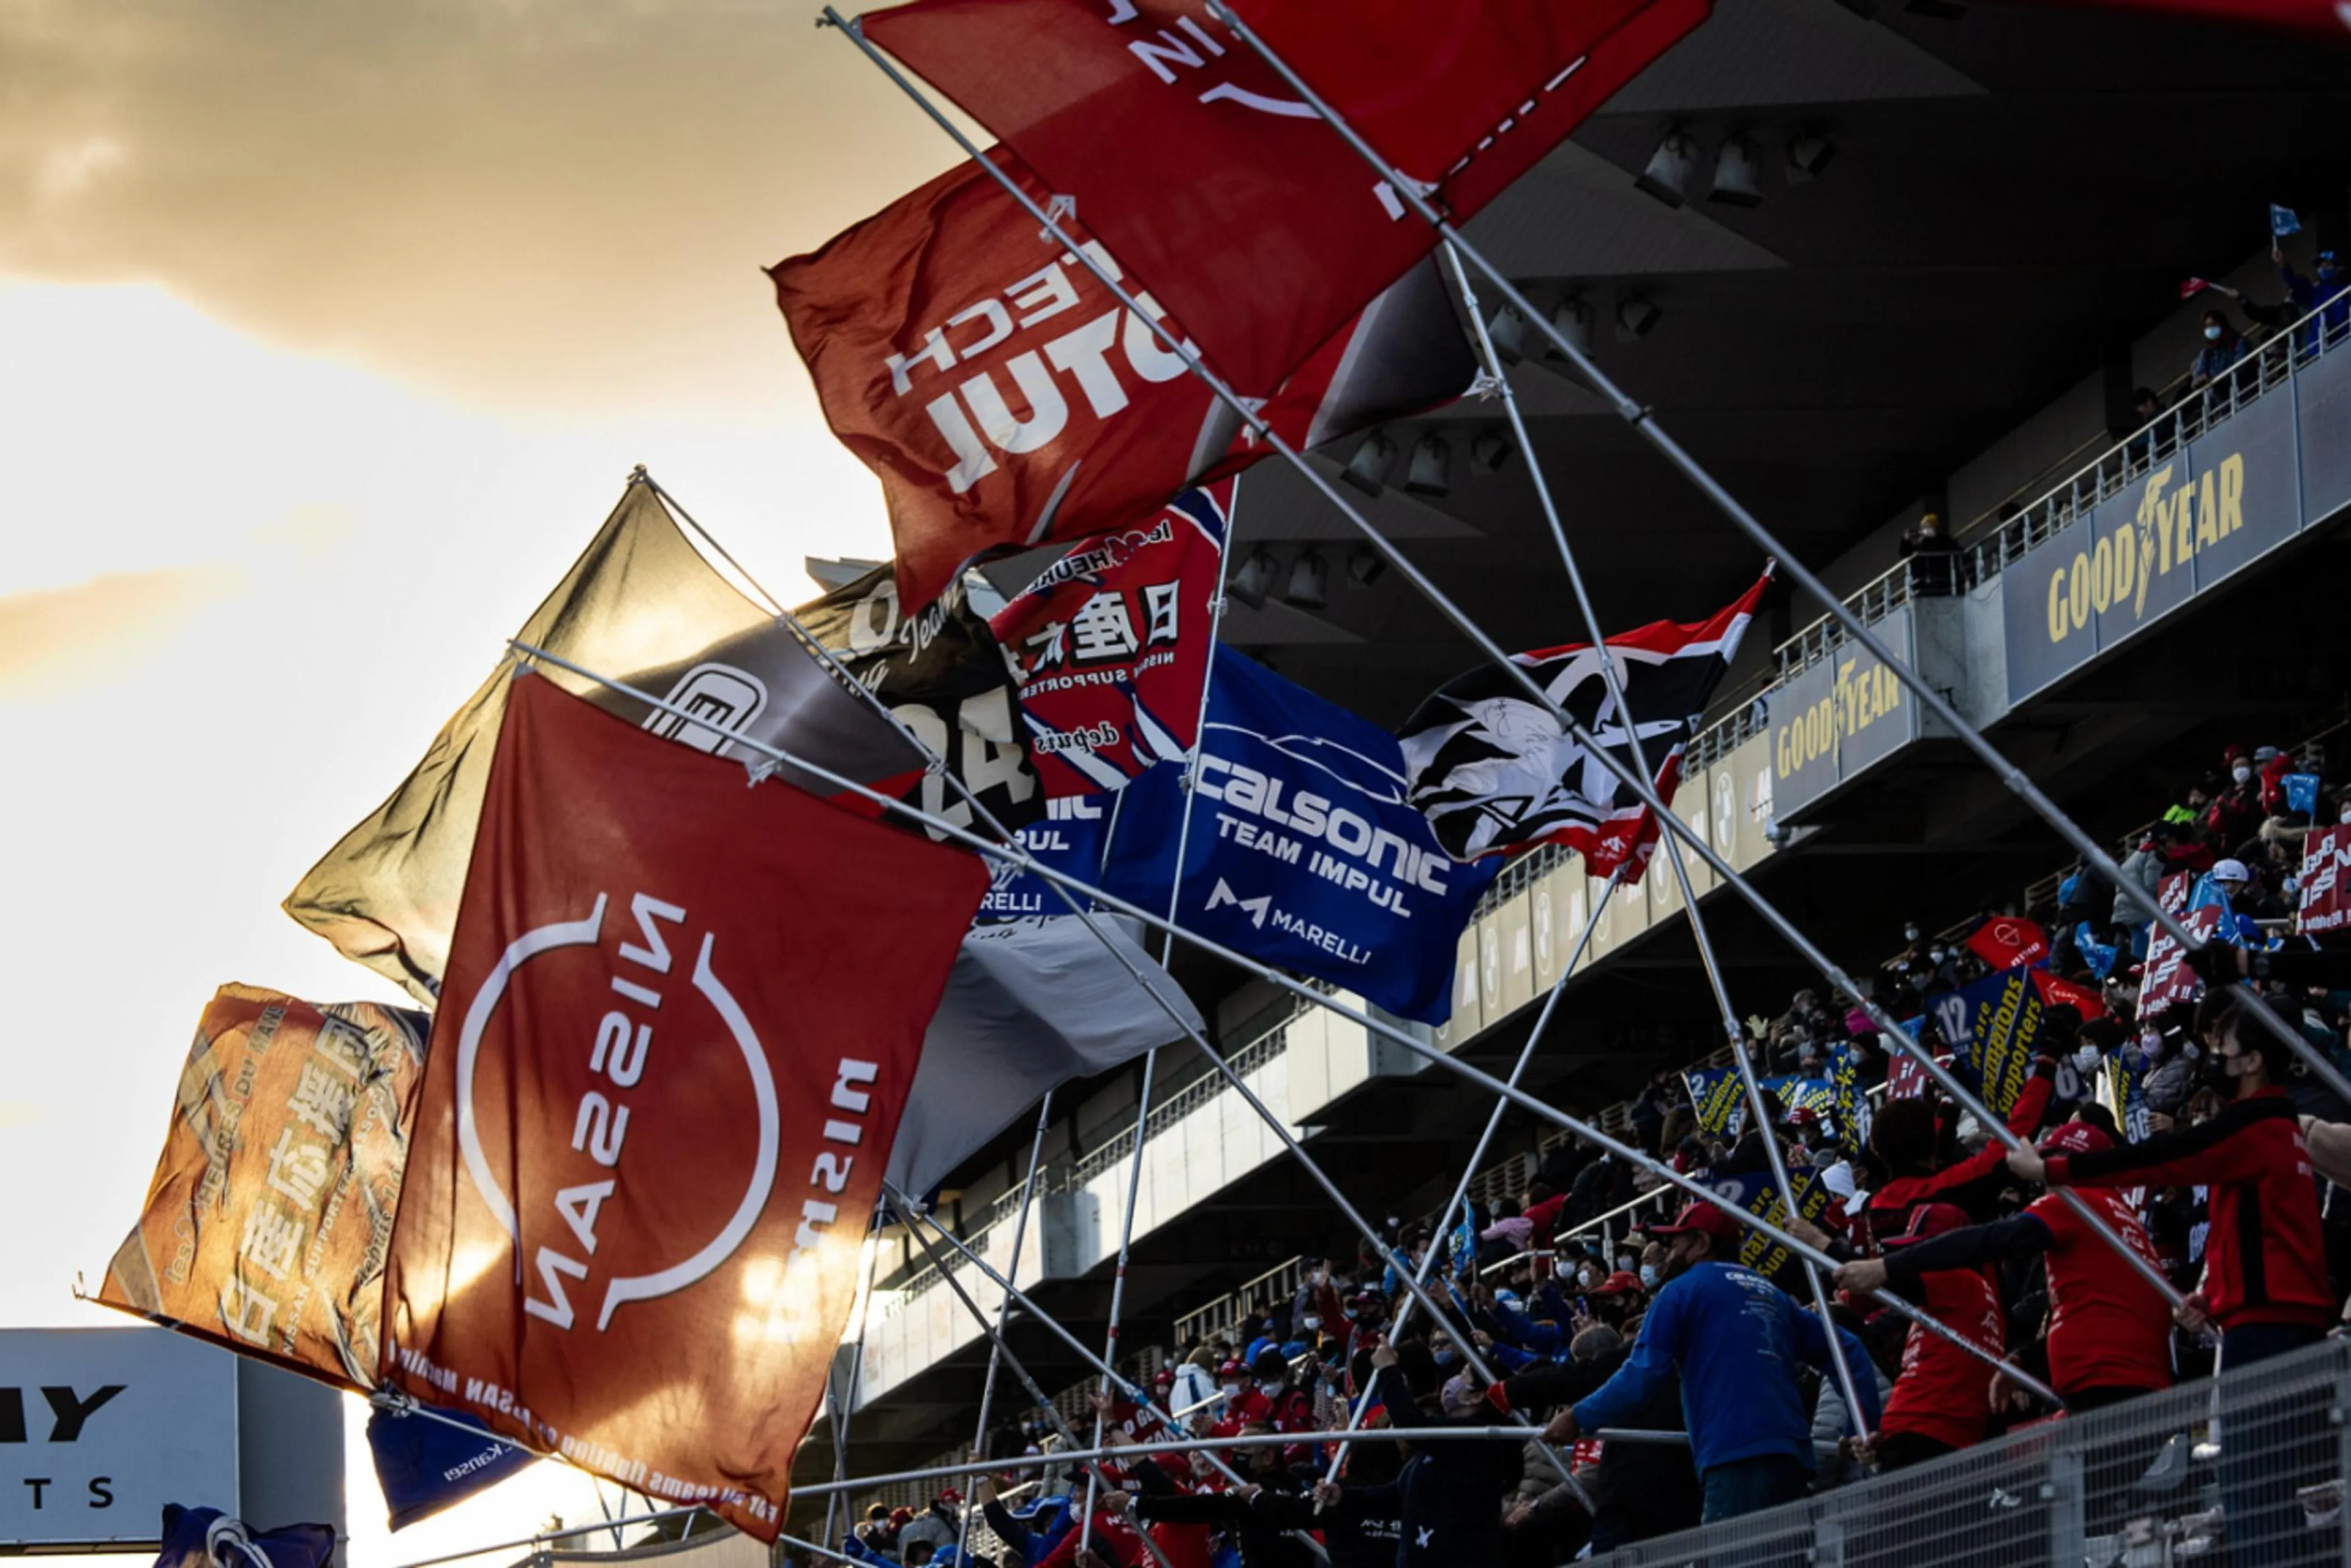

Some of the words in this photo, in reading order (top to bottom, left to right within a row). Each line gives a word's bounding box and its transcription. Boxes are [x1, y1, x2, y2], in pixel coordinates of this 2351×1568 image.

[1216, 812, 1303, 865] TEAM
[1308, 841, 1411, 918] IMPUL
[978, 892, 1042, 912] RELLI
[1272, 908, 1371, 966] MARELLI
[1935, 994, 1974, 1044] 12
